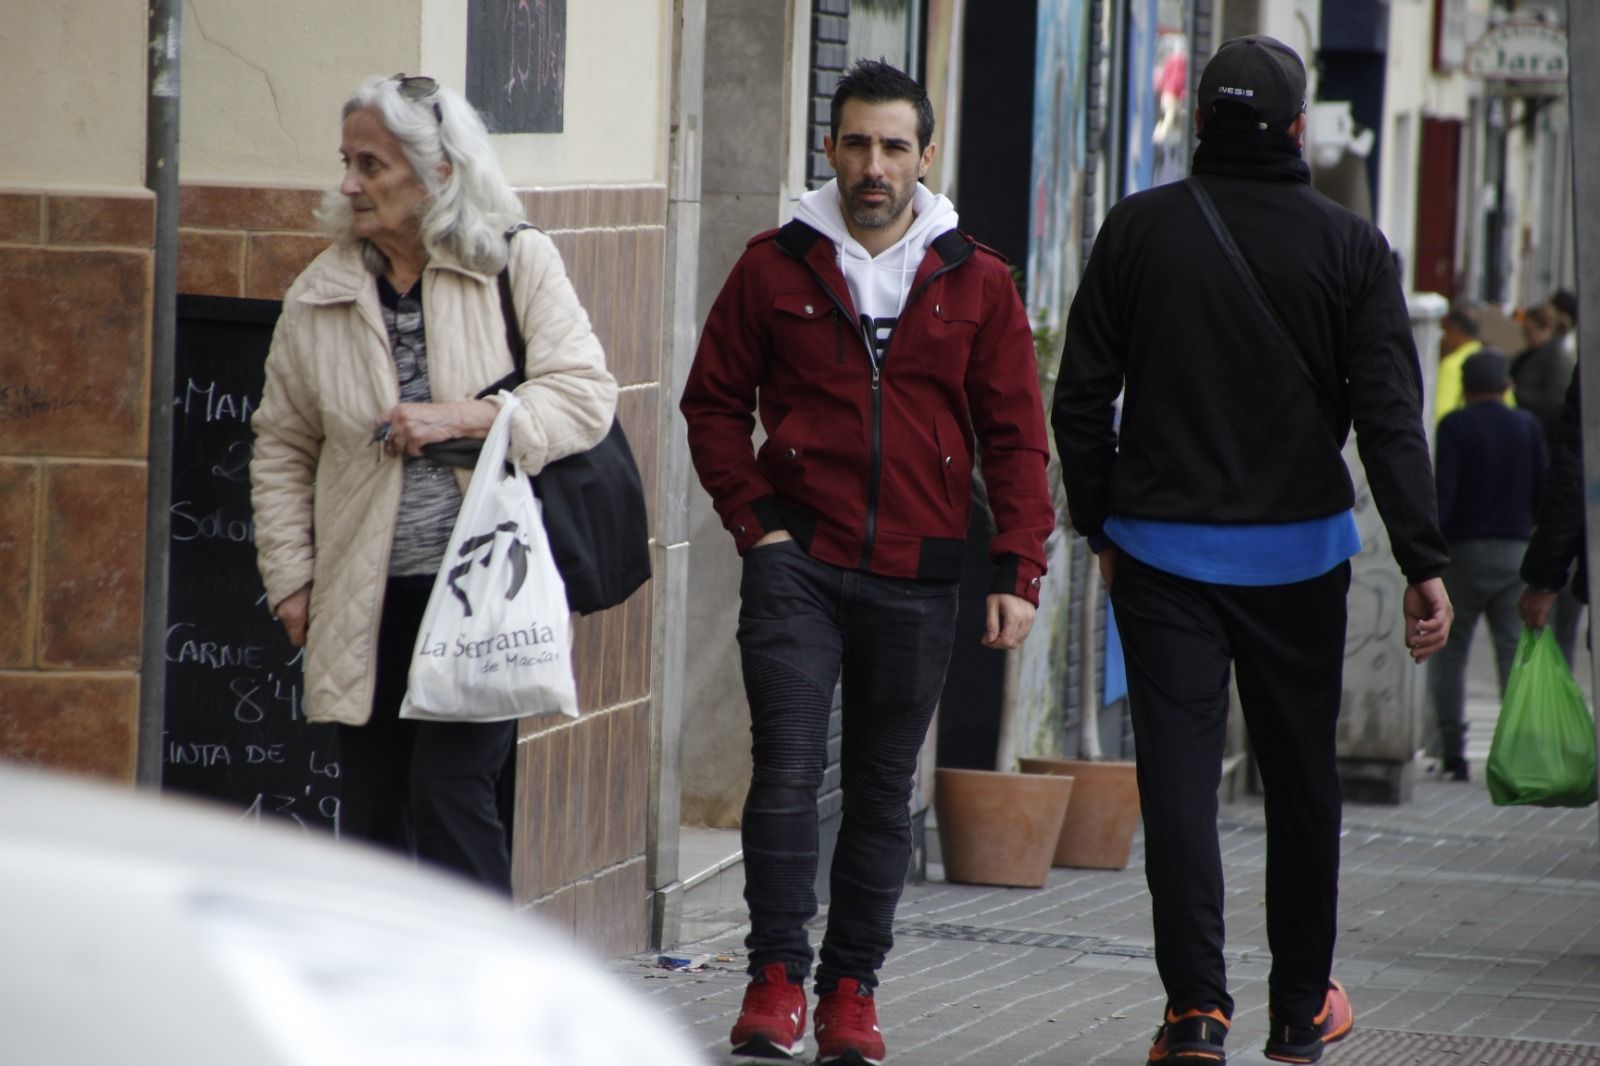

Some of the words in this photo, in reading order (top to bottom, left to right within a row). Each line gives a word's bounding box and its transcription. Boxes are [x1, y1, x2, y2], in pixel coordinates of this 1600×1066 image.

[165, 622, 265, 669] CARNE
[419, 632, 447, 658] La
[453, 621, 555, 658] Serranía
[230, 672, 307, 723] 8'4
[246, 745, 284, 763] DE
